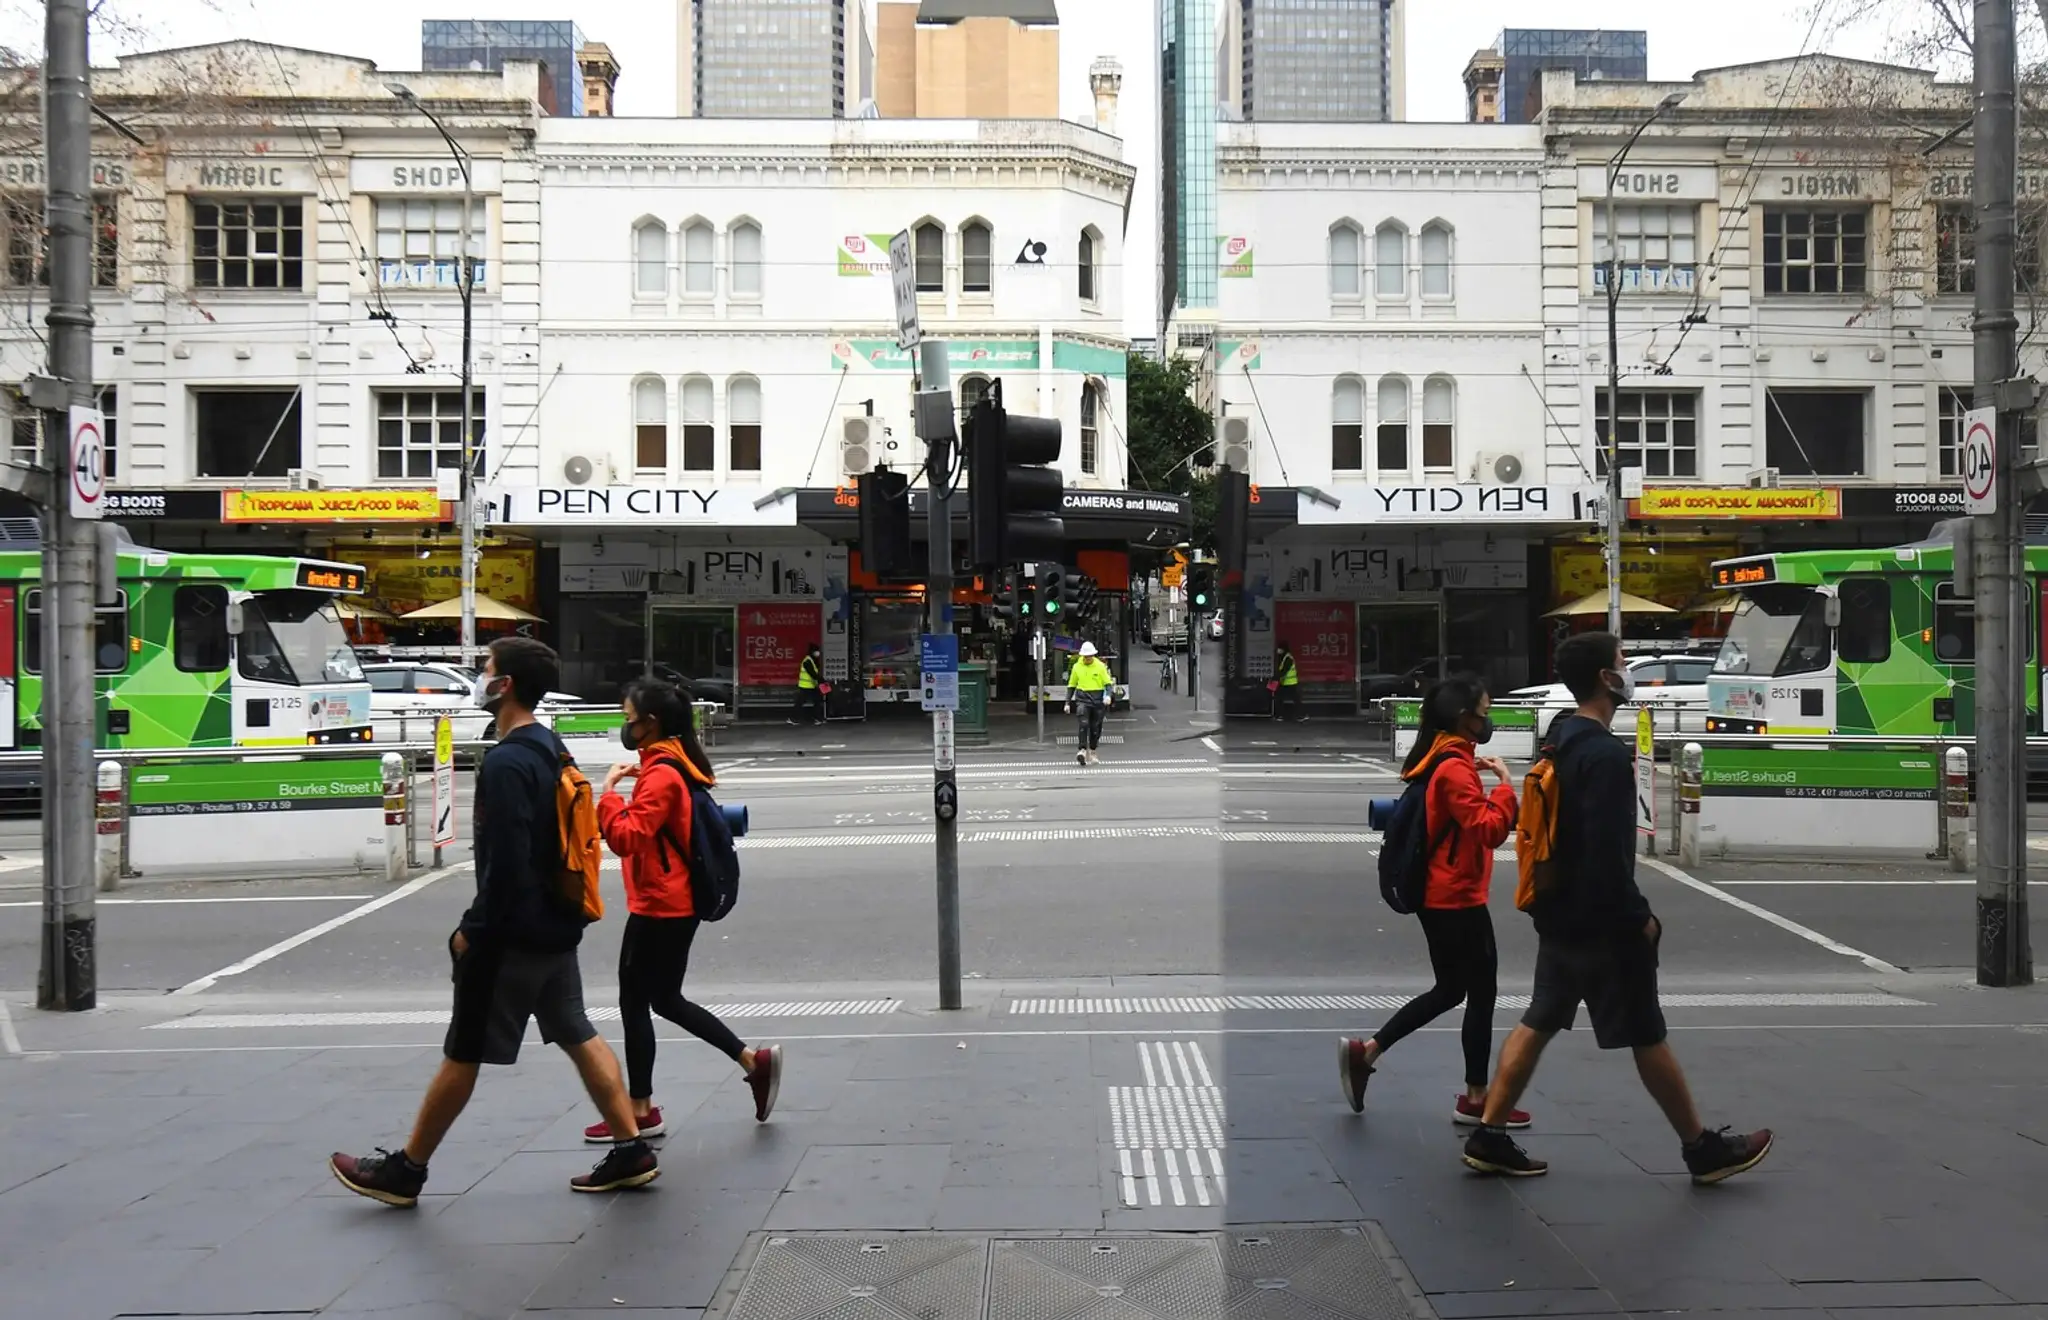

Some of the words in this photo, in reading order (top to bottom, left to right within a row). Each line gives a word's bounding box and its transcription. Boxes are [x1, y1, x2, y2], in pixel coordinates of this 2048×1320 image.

[200, 166, 283, 187] MAGIC
[393, 166, 460, 187] SHOP
[380, 261, 485, 282] TATTO
[76, 443, 100, 483] 40
[121, 495, 166, 508] BOOTS
[538, 489, 609, 513] PEN
[627, 489, 719, 513] CITY
[1062, 495, 1124, 509] CAMERAS
[1125, 498, 1144, 510] and
[1145, 499, 1179, 513] IMAGING
[704, 551, 763, 573] PEN
[746, 636, 778, 647] FOR
[745, 648, 794, 659] LEASE
[272, 697, 301, 710] 2125
[278, 783, 328, 796] Bourke
[330, 782, 370, 795] Street
[135, 805, 164, 814] Trams
[165, 805, 176, 813] to
[177, 803, 195, 814] City
[202, 802, 234, 812] Routes
